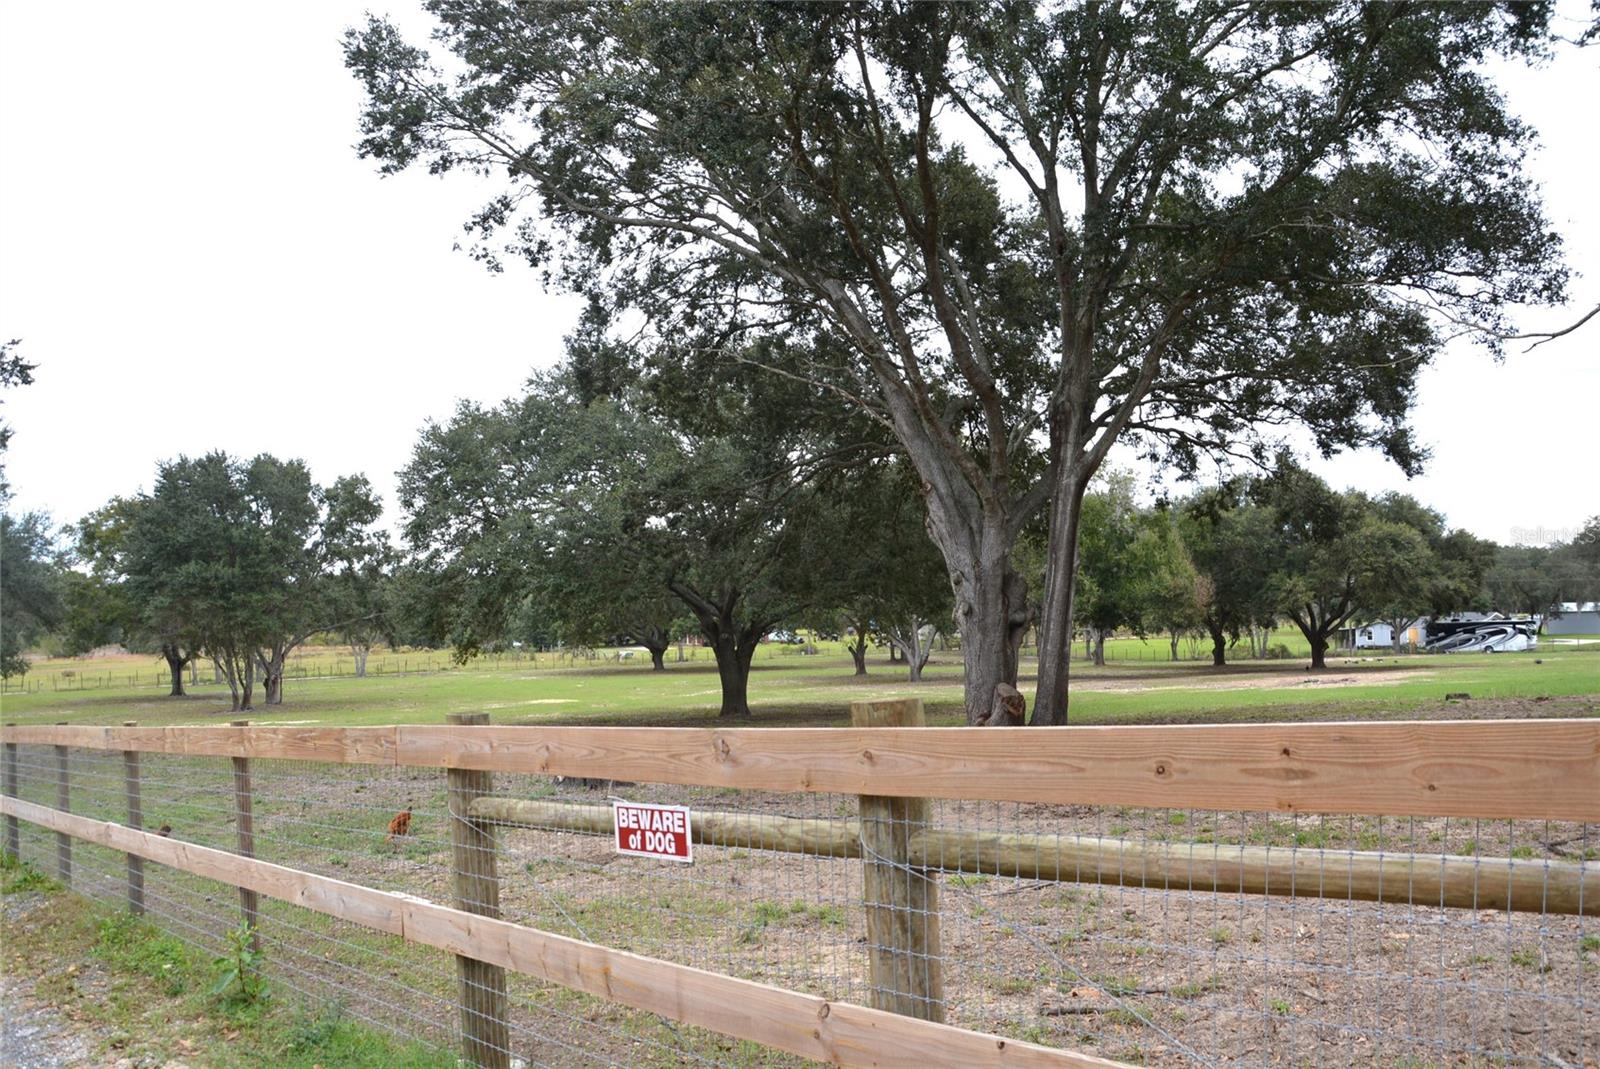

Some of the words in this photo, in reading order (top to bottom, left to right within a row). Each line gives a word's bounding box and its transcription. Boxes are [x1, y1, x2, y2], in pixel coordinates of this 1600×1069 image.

[618, 807, 685, 833] BEWARE
[628, 830, 642, 850] of
[645, 830, 676, 854] DOG
